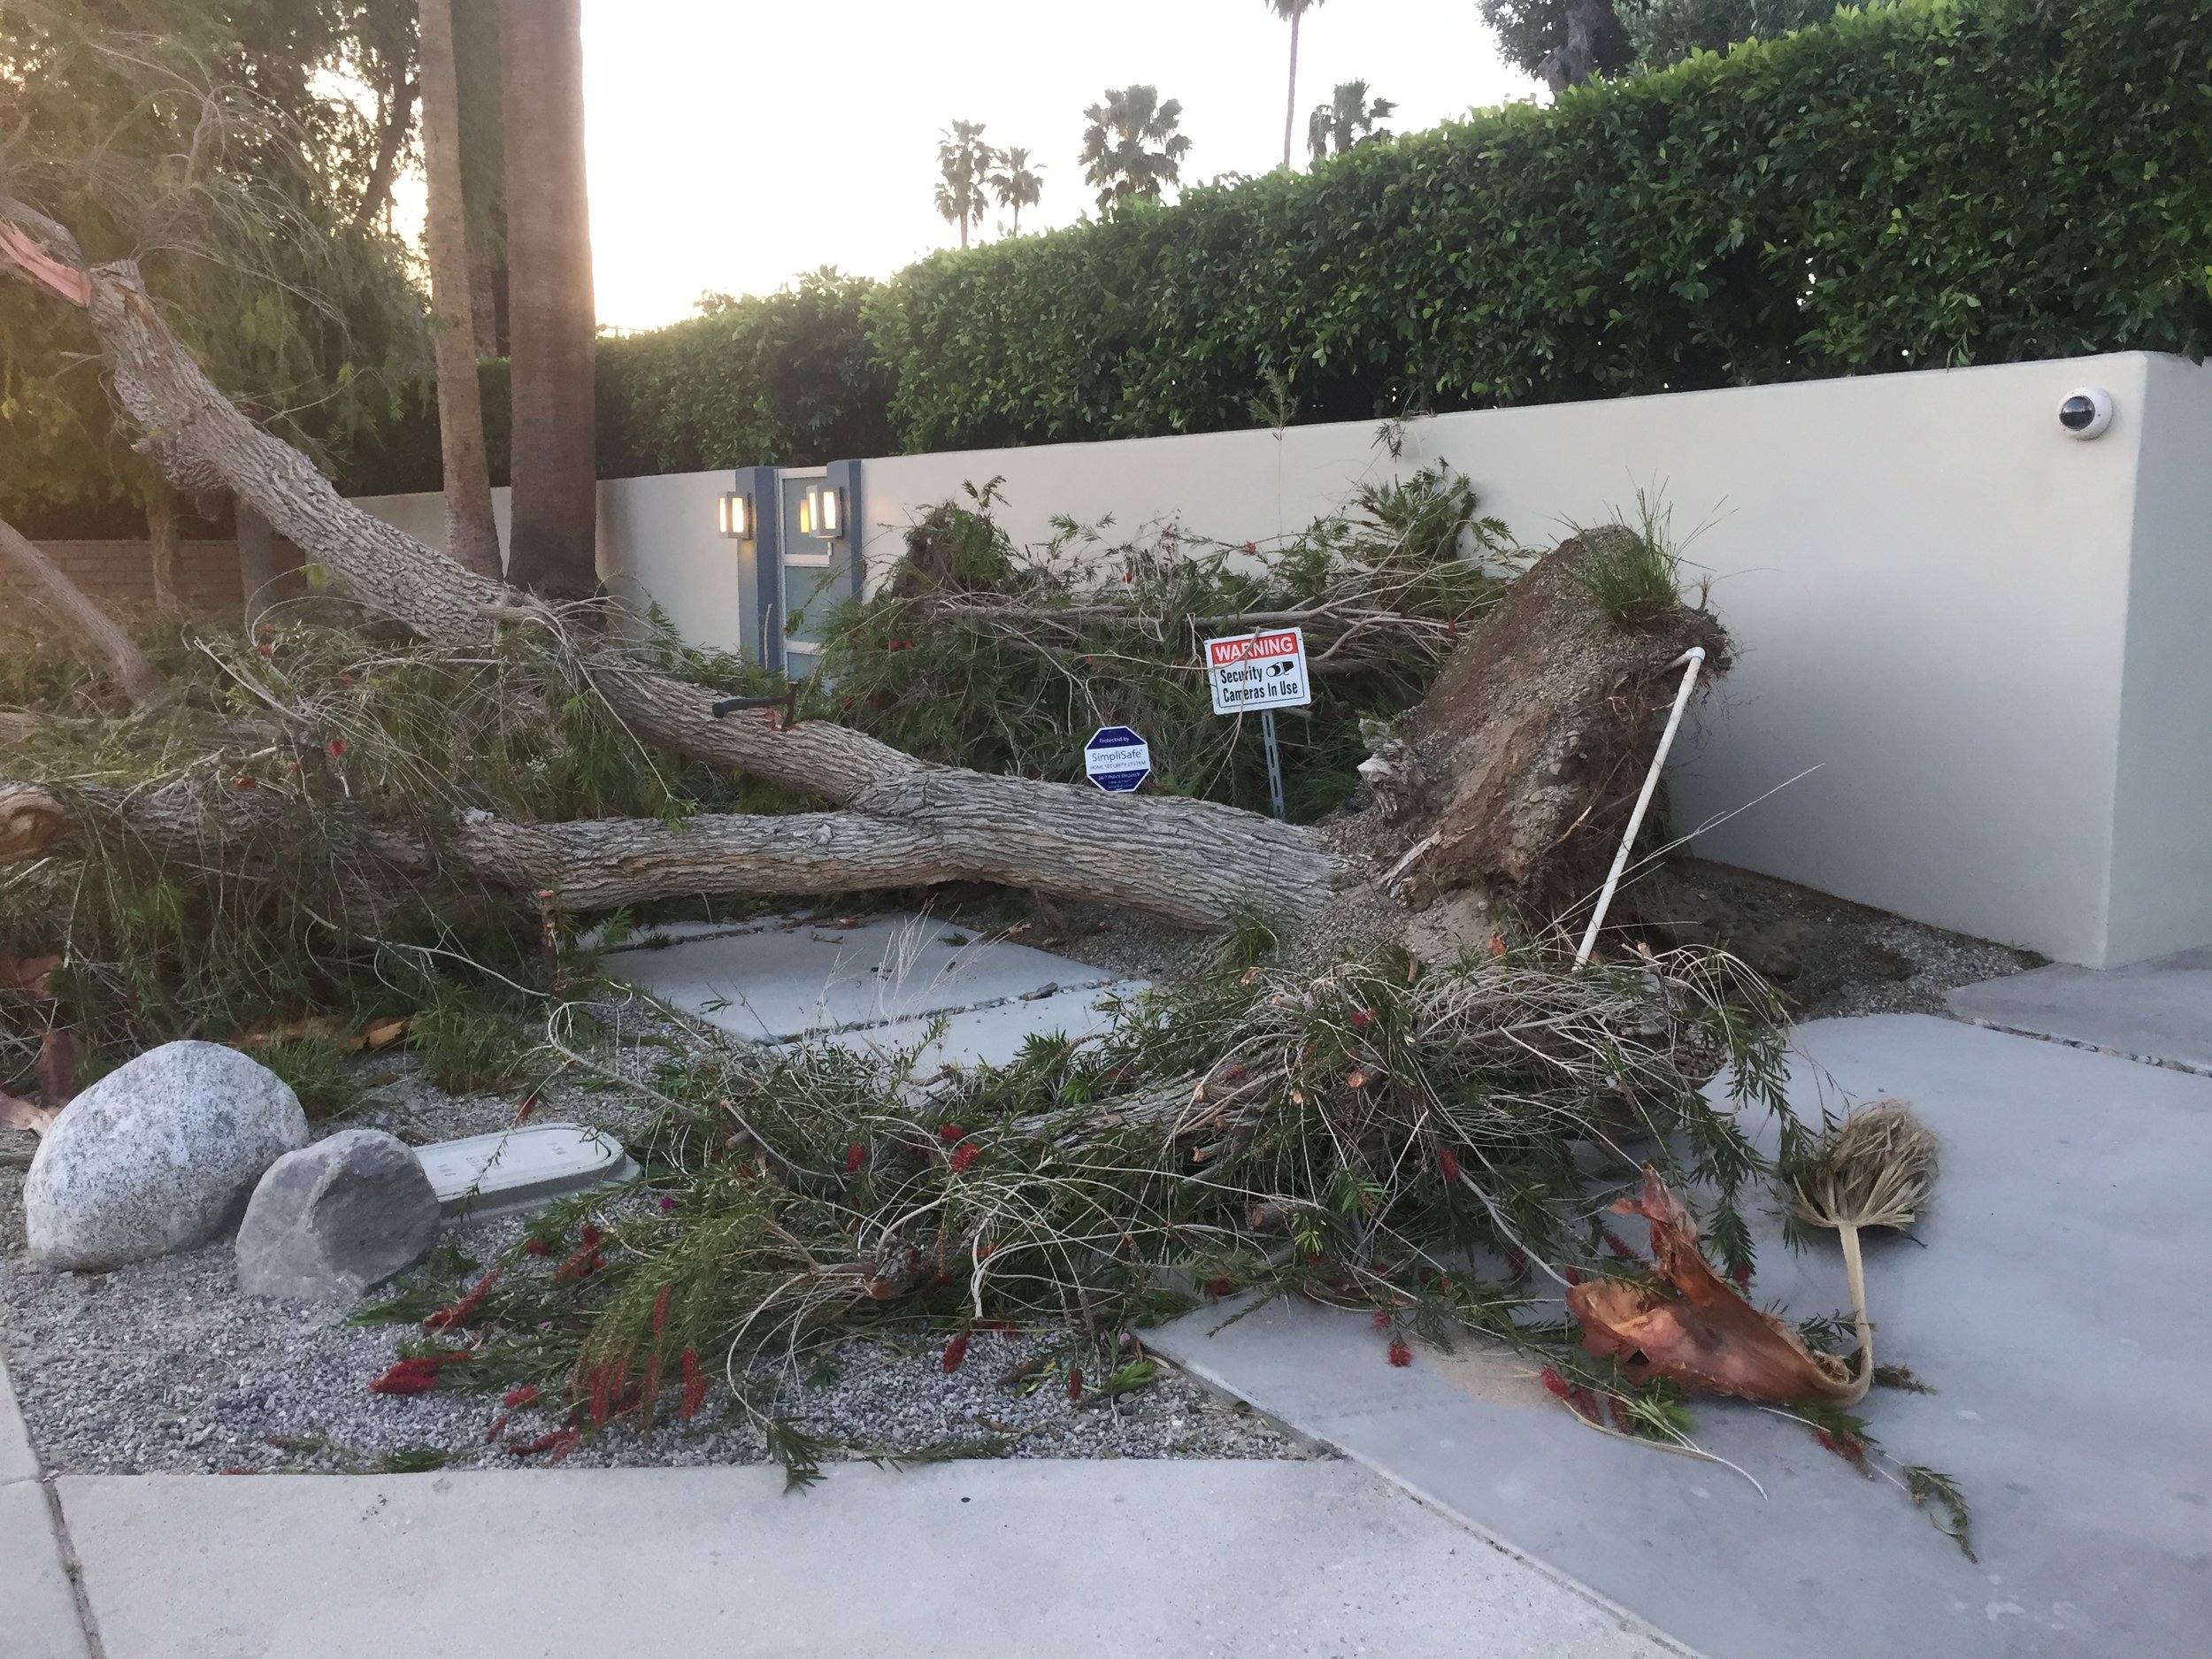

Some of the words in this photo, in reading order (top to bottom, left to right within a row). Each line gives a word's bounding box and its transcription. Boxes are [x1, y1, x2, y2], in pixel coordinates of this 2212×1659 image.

[1215, 637, 1293, 661] WARNING
[1220, 666, 1262, 684] Security
[1223, 687, 1265, 702] Cameras
[1267, 683, 1277, 697] In
[1279, 680, 1298, 695] Use
[1092, 749, 1141, 763] SimpliSafe
